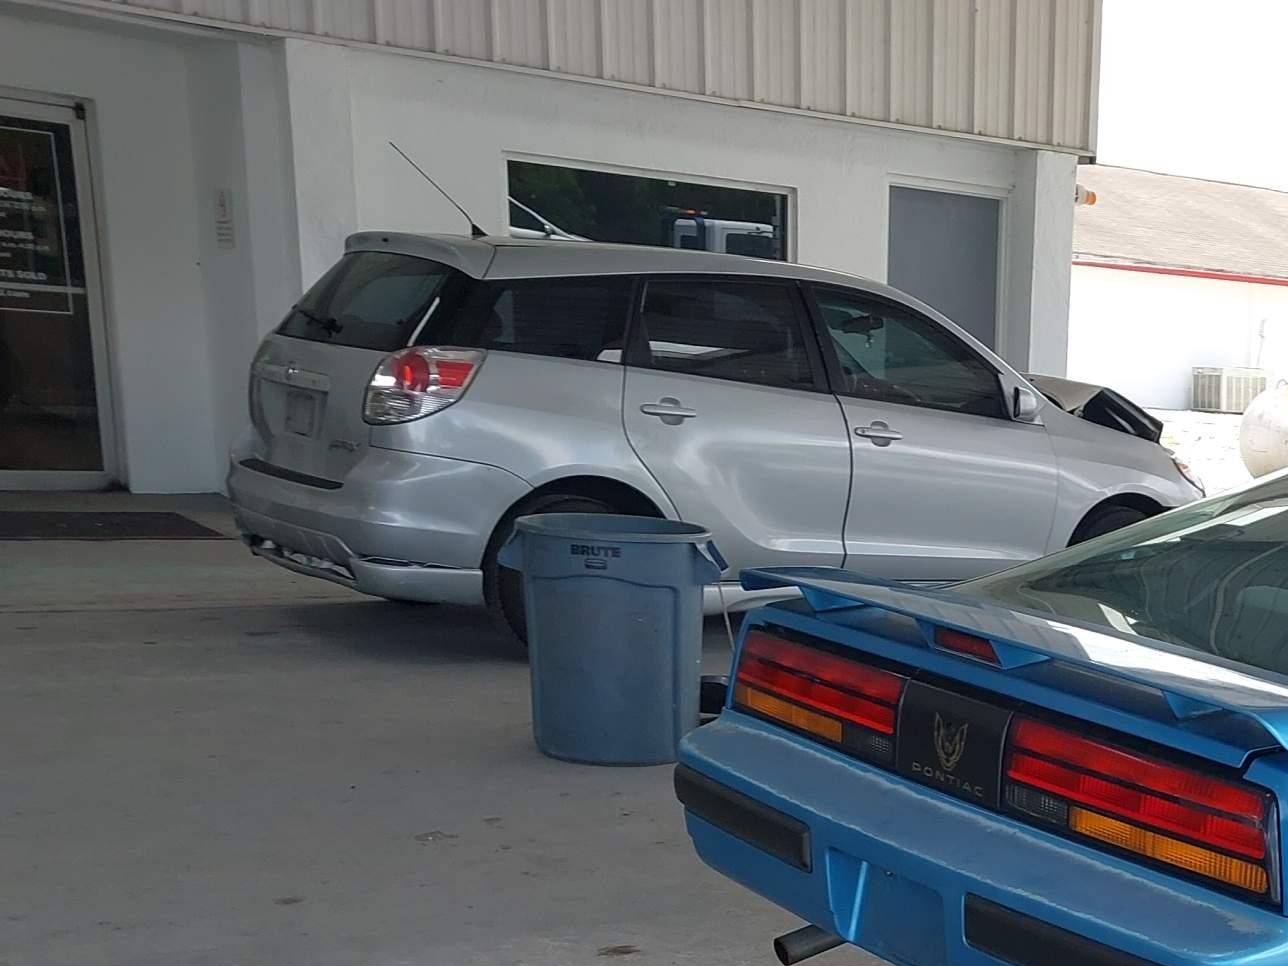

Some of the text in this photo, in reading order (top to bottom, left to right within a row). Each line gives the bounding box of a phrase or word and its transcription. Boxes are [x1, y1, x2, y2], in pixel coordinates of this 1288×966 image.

[16, 270, 48, 281] SOLD
[570, 544, 622, 558] BRUTE
[912, 762, 985, 797] PONTIAC
